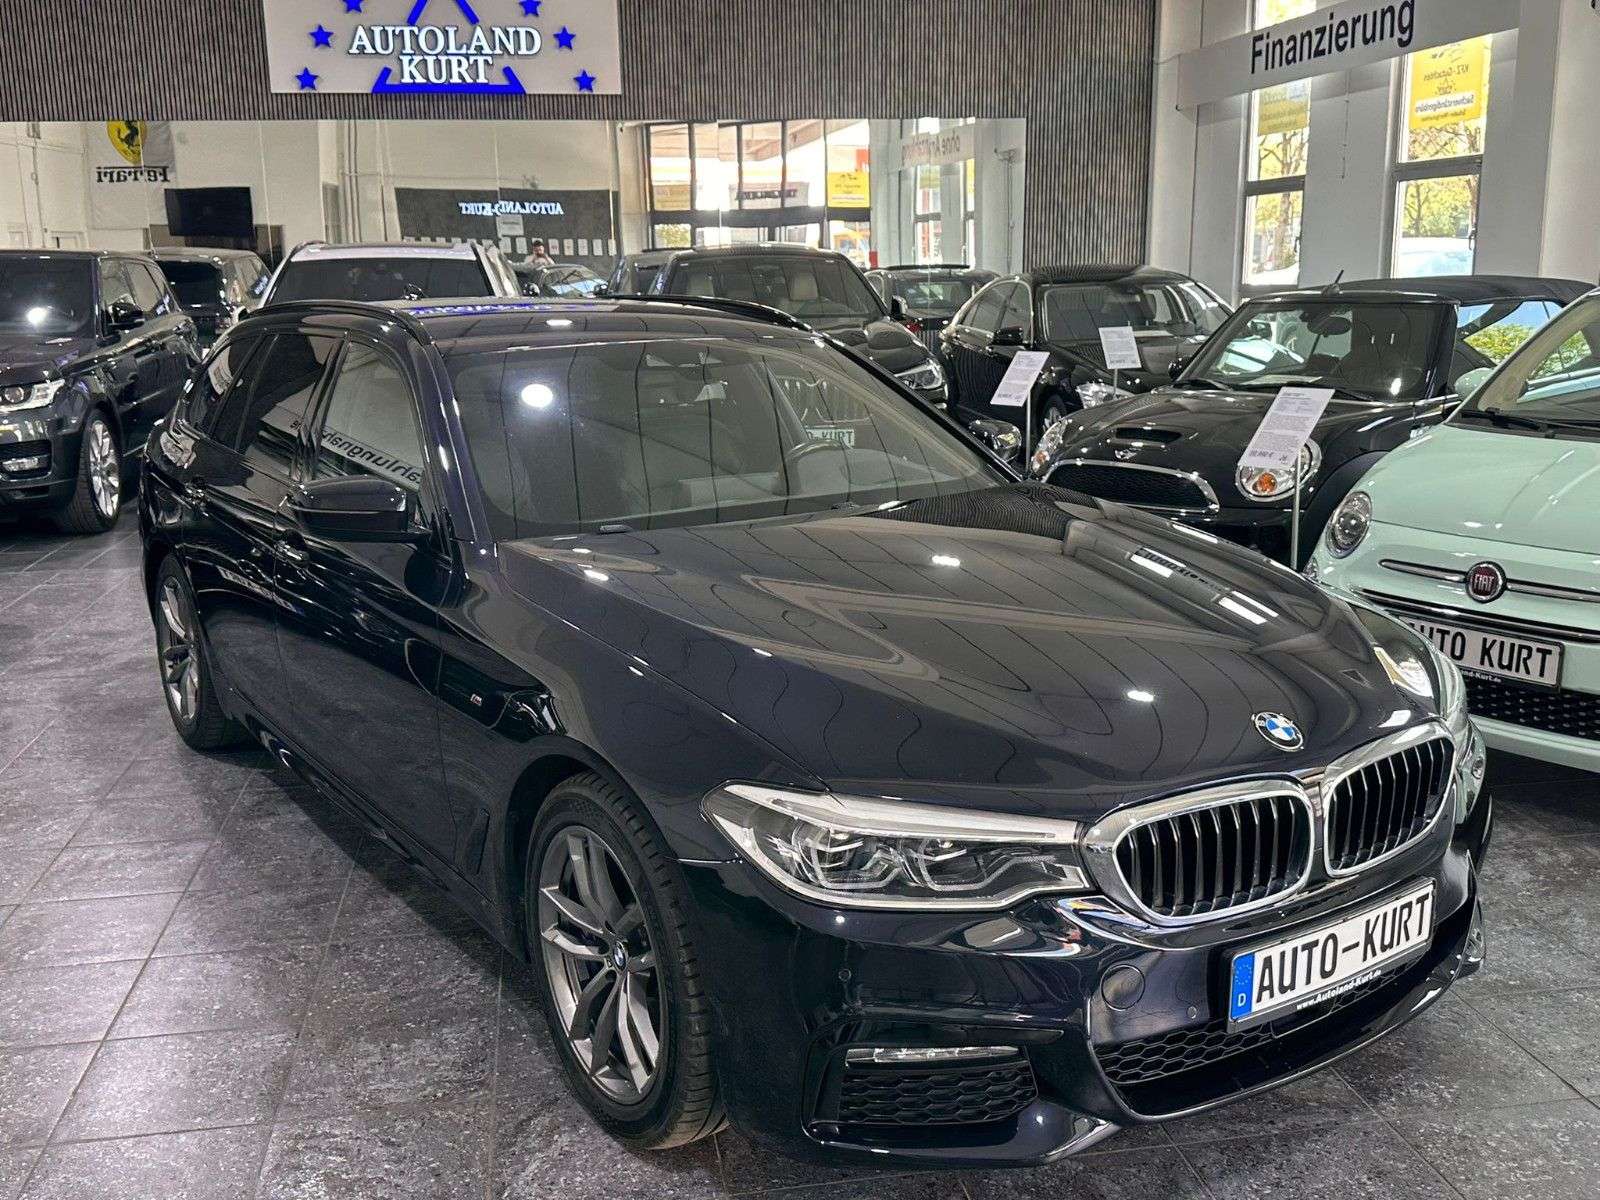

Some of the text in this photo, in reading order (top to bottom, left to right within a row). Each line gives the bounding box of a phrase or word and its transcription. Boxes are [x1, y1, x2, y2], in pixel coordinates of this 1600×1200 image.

[349, 25, 542, 56] AUTOLAND
[1250, 0, 1415, 74] Finanzierung
[400, 55, 494, 85] KURT
[1474, 572, 1495, 594] FIAT
[1409, 622, 1553, 678] TO KURT
[1236, 895, 1430, 1008] D AUTO-KURT
[1296, 969, 1382, 1011] www.Autoland-Kurt.de
